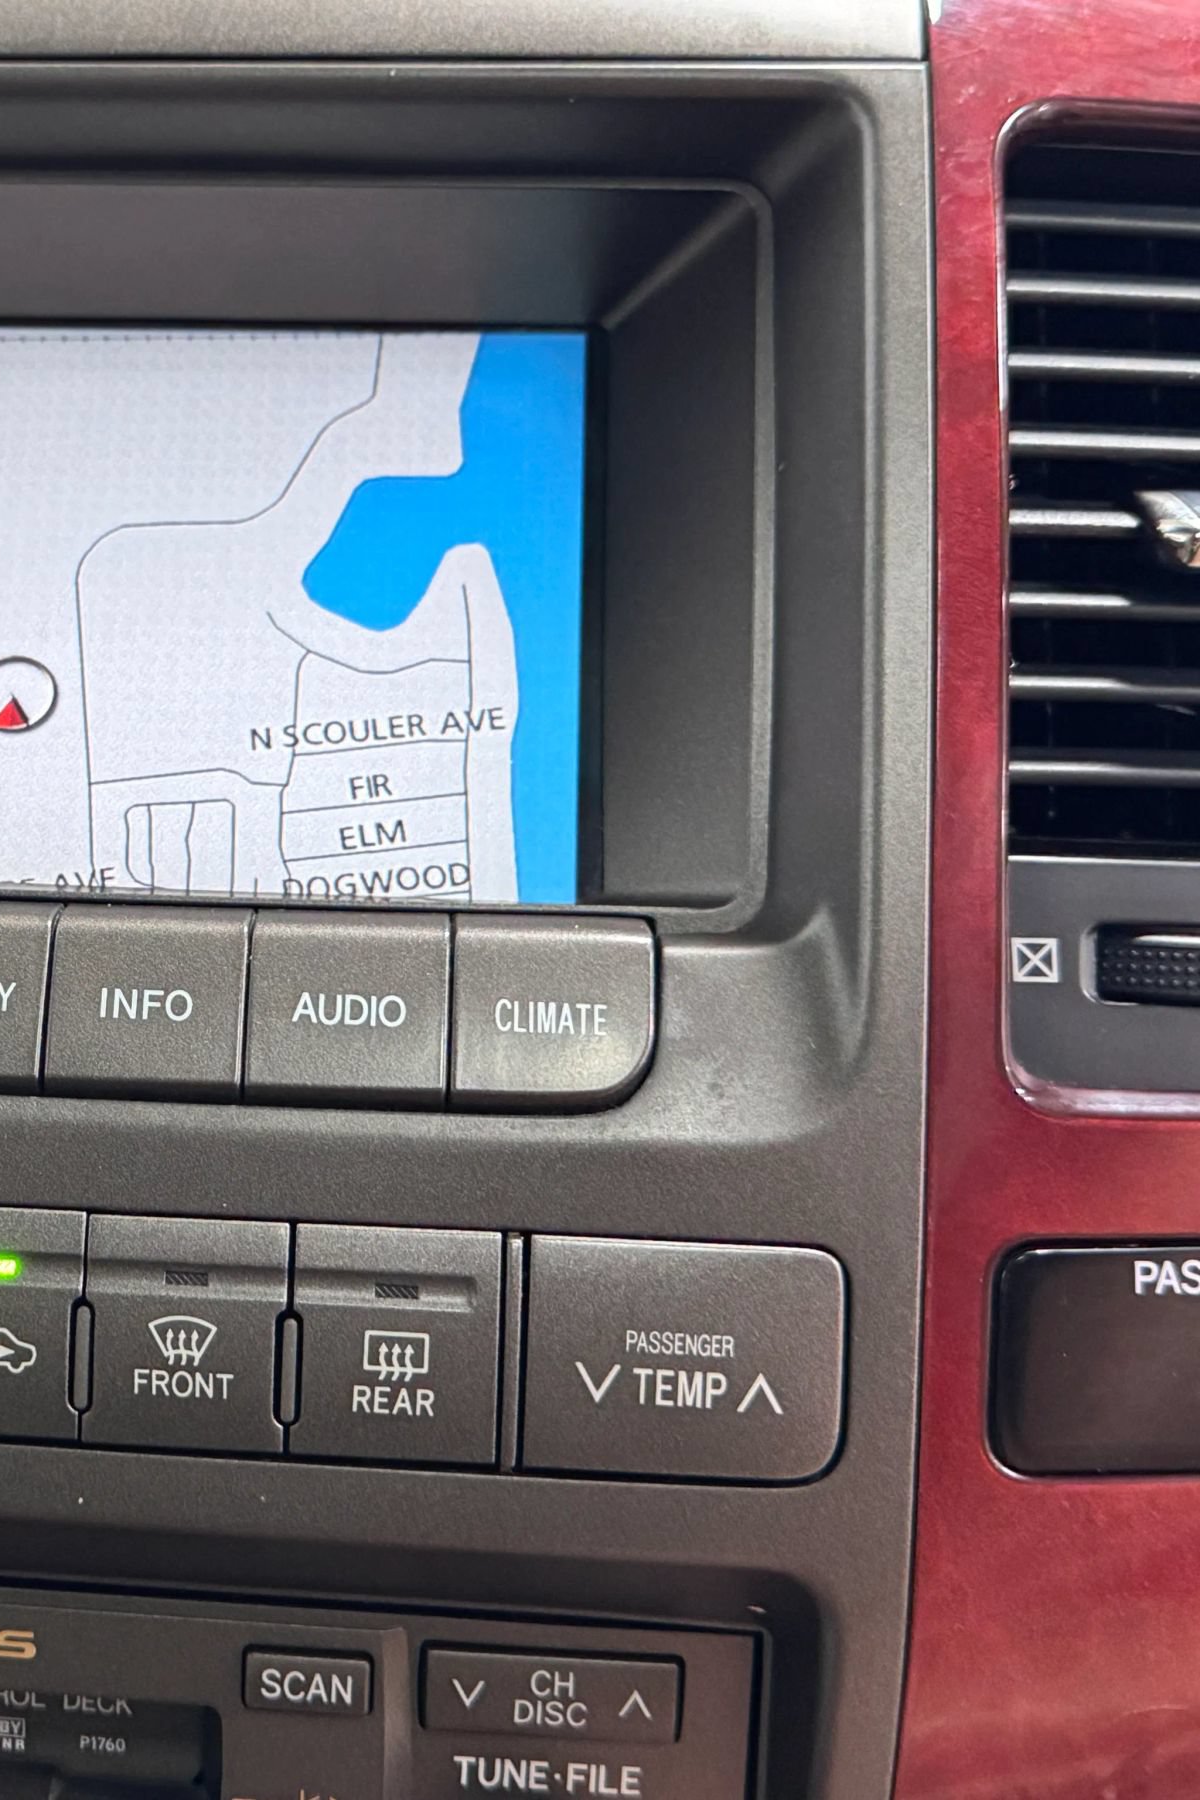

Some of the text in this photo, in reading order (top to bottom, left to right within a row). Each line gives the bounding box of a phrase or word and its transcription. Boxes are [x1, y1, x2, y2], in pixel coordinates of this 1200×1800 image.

[250, 707, 506, 751] N SCOULER AVE
[349, 774, 393, 800] FIR
[339, 820, 407, 850] ELM
[282, 863, 470, 896] DOGWOOD
[99, 987, 193, 1022] INFO
[292, 991, 406, 1028] AUDIO
[494, 998, 609, 1037] CLIMATE
[625, 1330, 735, 1358] PASSENGER
[133, 1368, 235, 1400] FRONT
[633, 1367, 728, 1410] TEMP
[351, 1384, 435, 1418] REAR
[260, 1668, 353, 1705] SCAN
[530, 1670, 576, 1699] CH
[513, 1700, 588, 1729] DISC
[2, 1739, 26, 1751] NR
[80, 1736, 127, 1752] P1760
